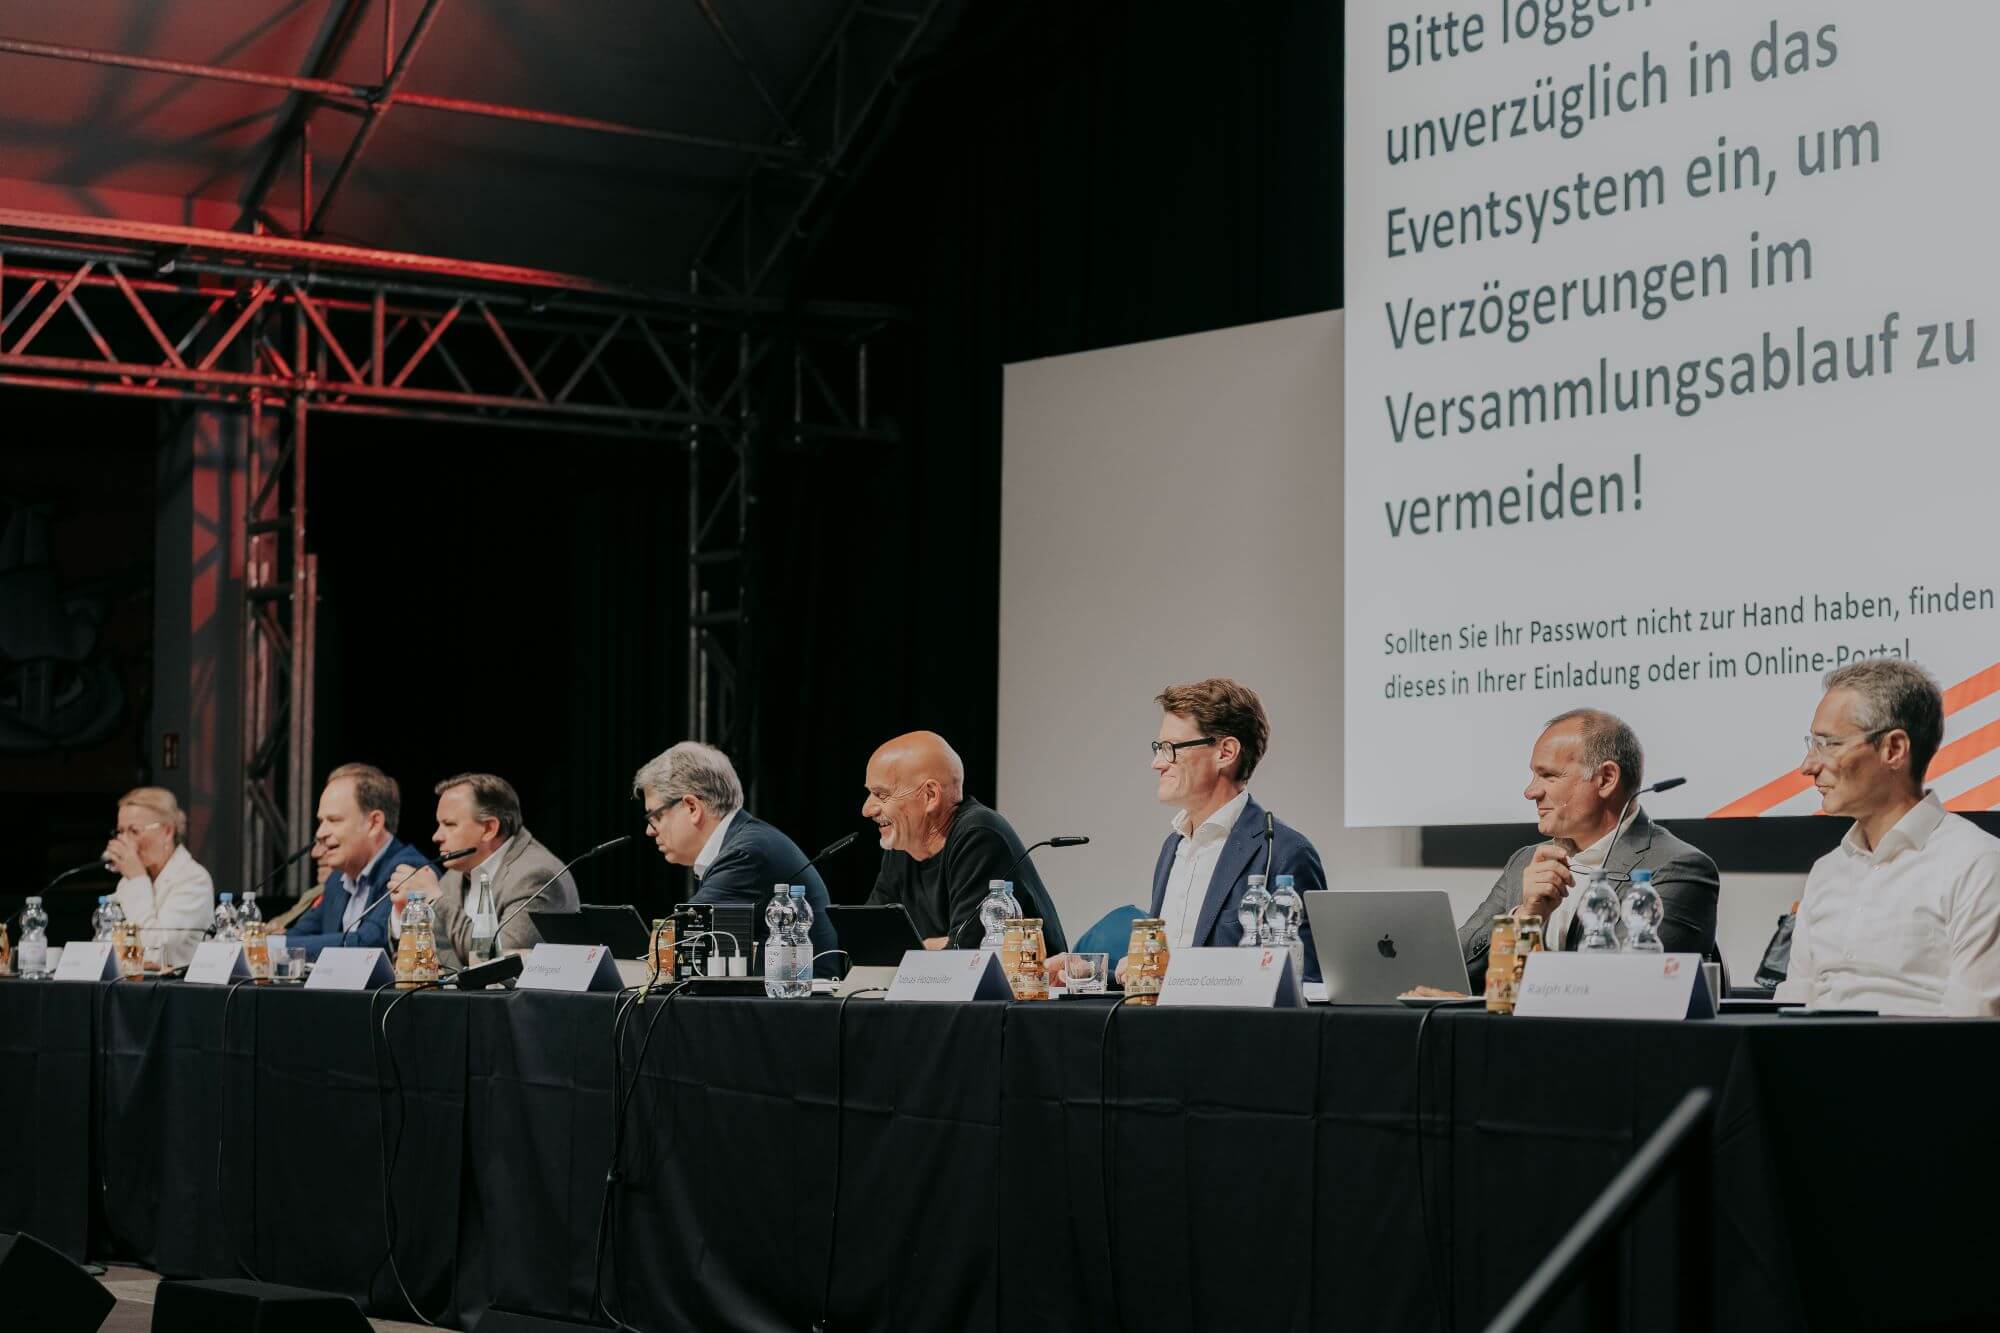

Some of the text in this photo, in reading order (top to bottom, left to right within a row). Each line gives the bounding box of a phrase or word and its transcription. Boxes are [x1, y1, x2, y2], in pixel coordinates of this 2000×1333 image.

[1388, 0, 1651, 73] Bitte logg
[1387, 19, 1837, 166] unverzüglich in das
[1387, 121, 1879, 259] Eventsystem ein, um
[1385, 231, 1812, 349] Verzögerungen im
[1385, 312, 1975, 443] Versammlungsablauf zu
[1385, 453, 1642, 537] vermeiden!
[1385, 582, 1993, 655] Sollten Sie Ihr Passwort nicht zur Hand haben, finden
[1385, 674, 1446, 699] dieses
[1452, 670, 1468, 695] in
[1478, 668, 1526, 693] Ihrer
[1535, 660, 1640, 690] Einladung
[1648, 654, 1701, 682] oder
[1709, 652, 1736, 679] im
[1168, 976, 1245, 986] Lorenzo Colombini
